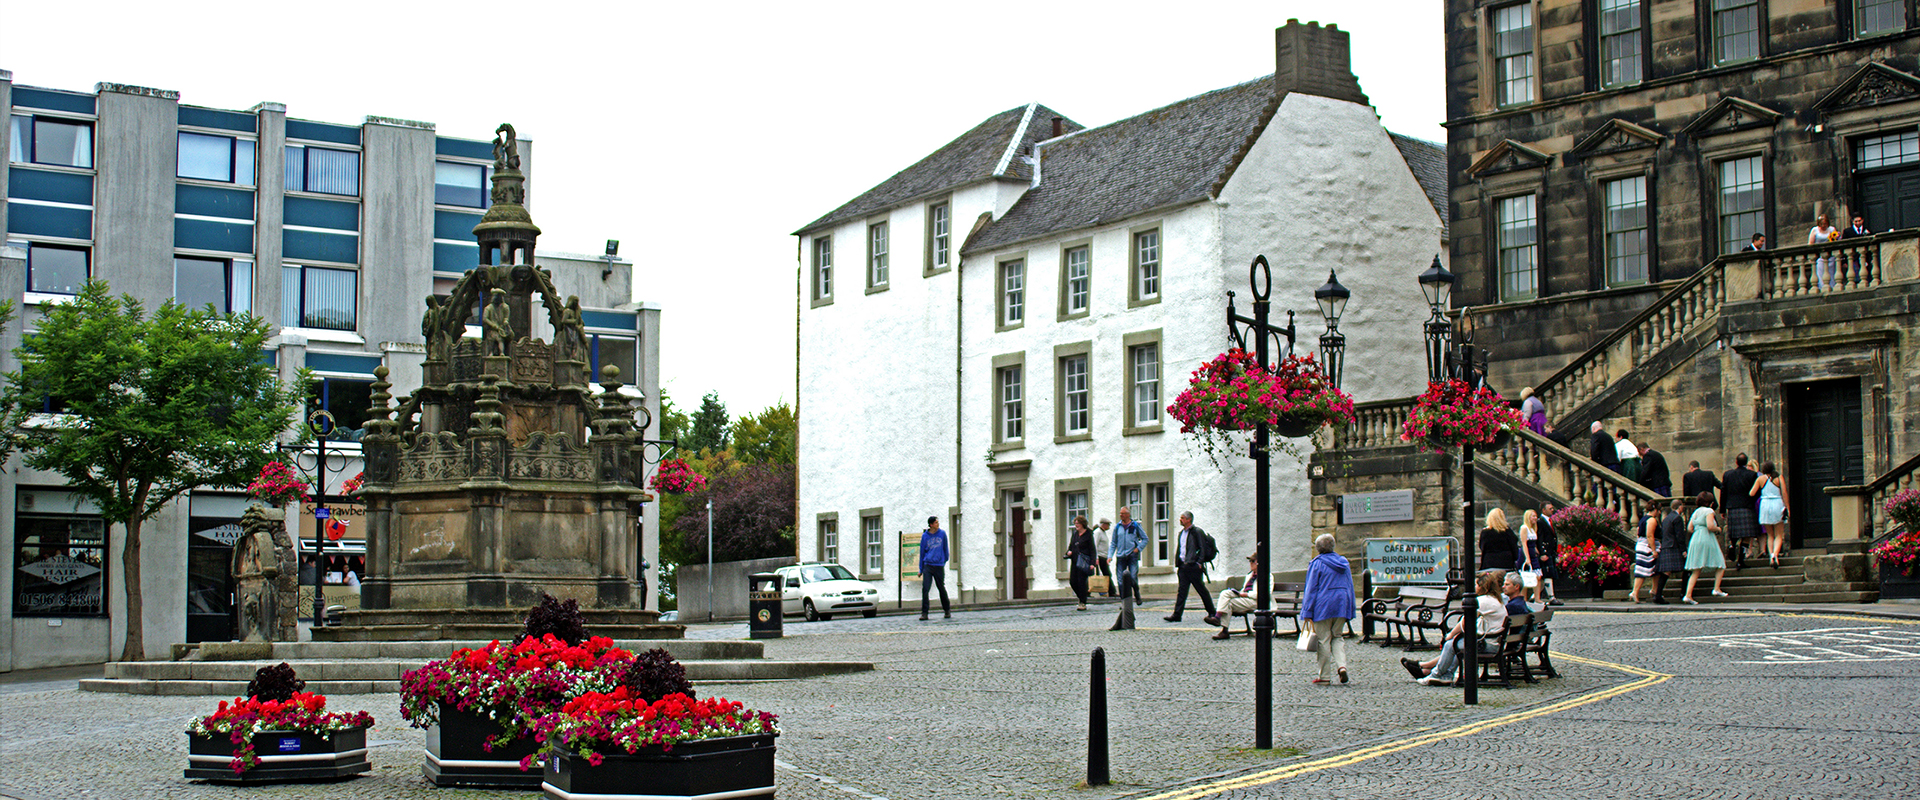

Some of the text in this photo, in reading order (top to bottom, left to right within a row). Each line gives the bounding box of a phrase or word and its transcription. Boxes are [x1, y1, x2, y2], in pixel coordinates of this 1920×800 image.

[1384, 544, 1433, 553] CAFE AT THE
[1382, 555, 1436, 564] BURGH HALLS
[1384, 566, 1434, 575] OPEN 7 DAYS
[20, 593, 100, 606] 01506 844800
